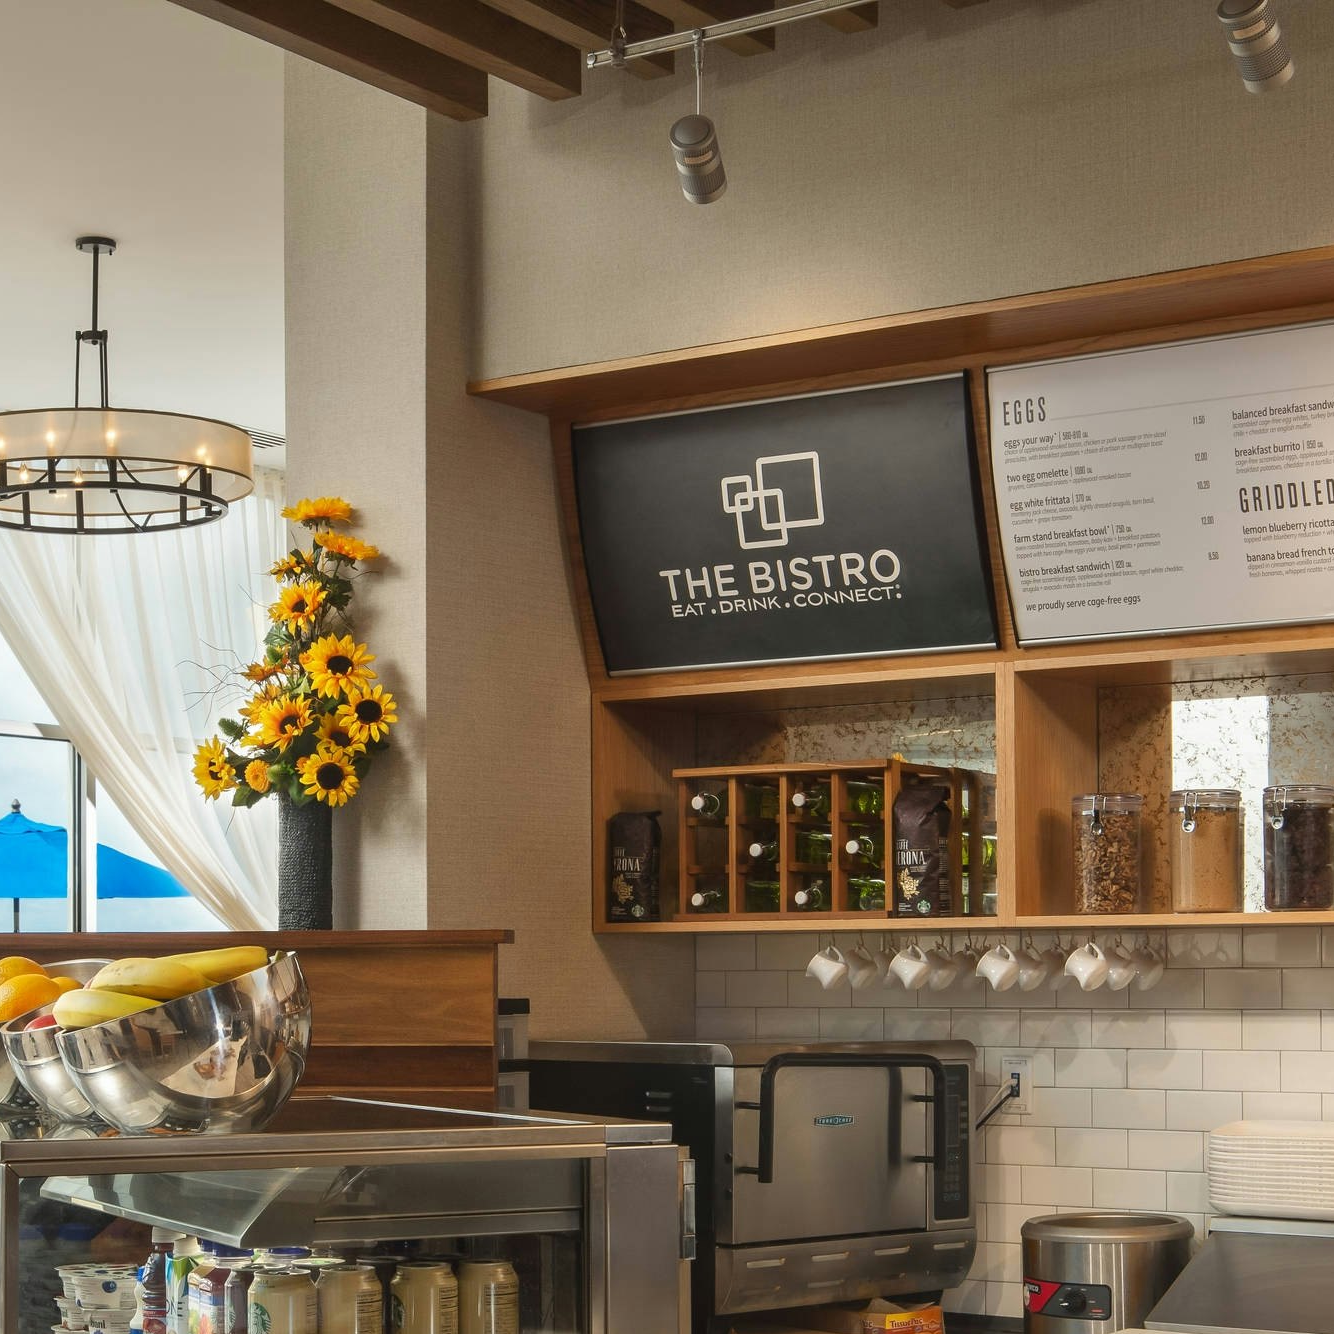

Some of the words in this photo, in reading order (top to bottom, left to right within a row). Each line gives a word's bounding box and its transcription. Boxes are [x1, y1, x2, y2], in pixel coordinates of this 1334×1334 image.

[1002, 396, 1046, 426] EGGS
[1231, 406, 1268, 420] balanced
[1269, 402, 1307, 416] breakfast
[1003, 438, 1021, 450] eggs
[1021, 436, 1038, 448] your
[1234, 444, 1272, 457] breakfast
[1273, 442, 1301, 453] burrito
[1006, 474, 1021, 482] two
[1021, 473, 1036, 483] egg
[1036, 468, 1069, 479] omelette
[1014, 534, 1032, 543] farm
[1032, 530, 1053, 542] stand
[1053, 528, 1088, 540] breakfast
[1242, 525, 1268, 535] lemon
[1268, 521, 1307, 532] blueberry
[1246, 552, 1276, 562] banana
[1276, 548, 1300, 559] bread
[1301, 545, 1327, 557] french
[659, 564, 739, 601] THE
[749, 549, 901, 593] BISTRO
[1019, 568, 1041, 577] bistro
[1040, 564, 1076, 575] breakfast
[1076, 560, 1111, 572] sandwich
[671, 603, 704, 617] EAT
[720, 596, 782, 614] DRINK
[1038, 599, 1066, 613] proudly
[1066, 600, 1086, 608] serve
[1087, 595, 1122, 609] cage-free
[1123, 596, 1141, 606] eggs
